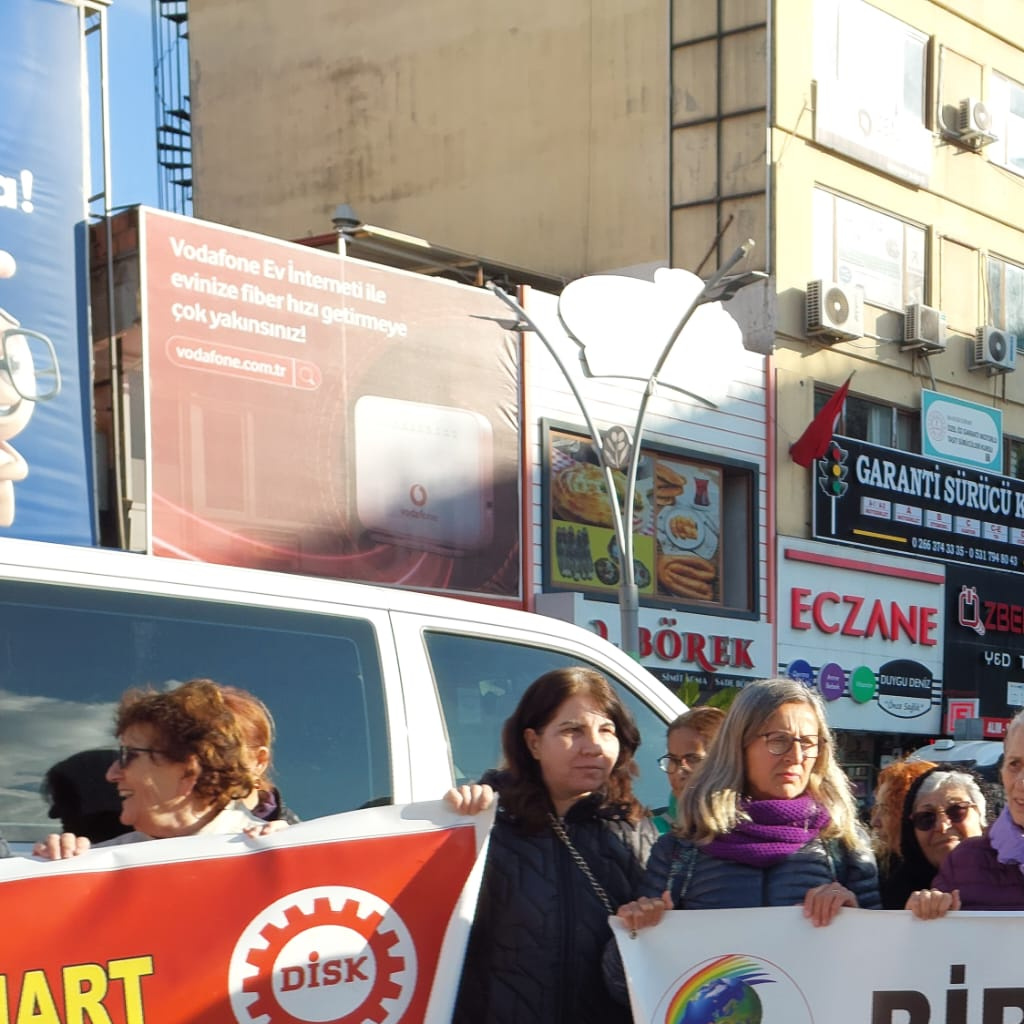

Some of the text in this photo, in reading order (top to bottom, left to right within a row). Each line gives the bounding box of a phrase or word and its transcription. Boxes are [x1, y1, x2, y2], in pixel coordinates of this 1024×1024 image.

[169, 237, 387, 305] Vodafone Ev İnterneti ile
[171, 271, 408, 338] evinize fiber hızı getirmeye
[171, 303, 307, 343] çok yakınsınız!
[176, 346, 287, 377] vodafone.com.tr
[856, 455, 941, 501] GARANTİ
[943, 469, 1012, 516] SÜRÜCÜ
[912, 537, 917, 548] 0
[968, 547, 974, 558] 0
[791, 587, 938, 646] ECZANE
[638, 616, 756, 673] BÖREK
[984, 650, 1011, 668] Y&D
[880, 674, 908, 687] DUYGU
[279, 951, 369, 992] DİSK
